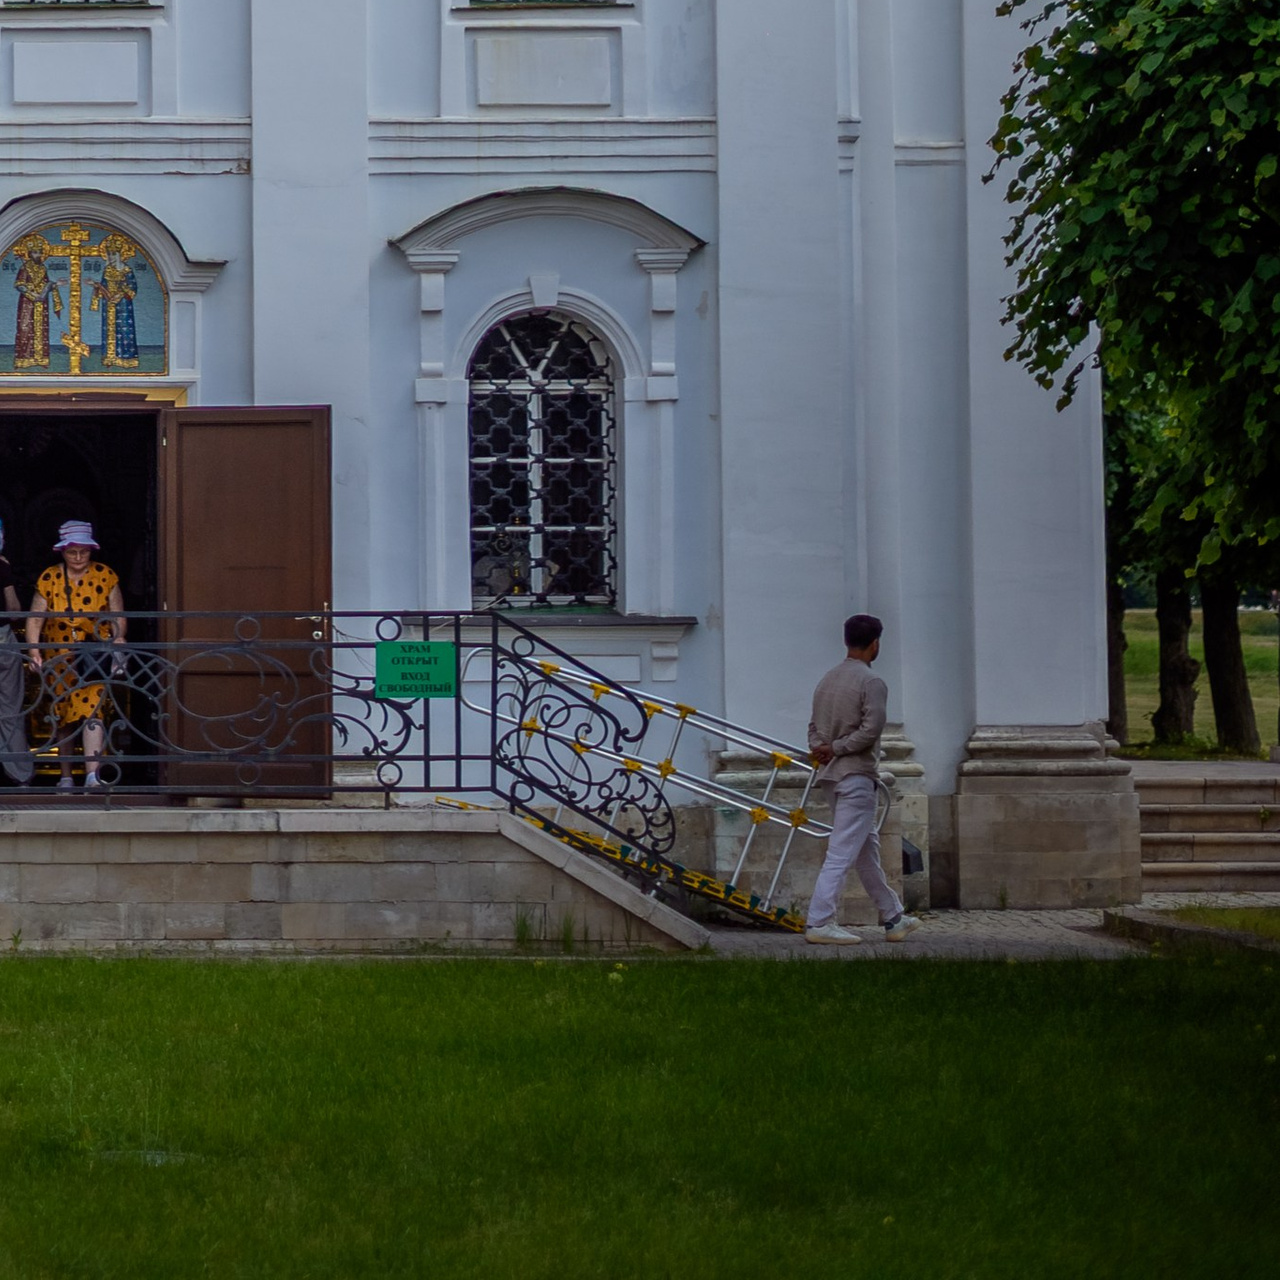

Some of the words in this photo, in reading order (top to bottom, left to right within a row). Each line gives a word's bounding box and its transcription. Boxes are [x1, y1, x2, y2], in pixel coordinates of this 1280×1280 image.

[400, 644, 431, 653] ХРАМ
[391, 656, 439, 665] ОТКРЫТ
[400, 671, 431, 681] ВХОД
[378, 682, 452, 692] СВОБОДНЫЙ
